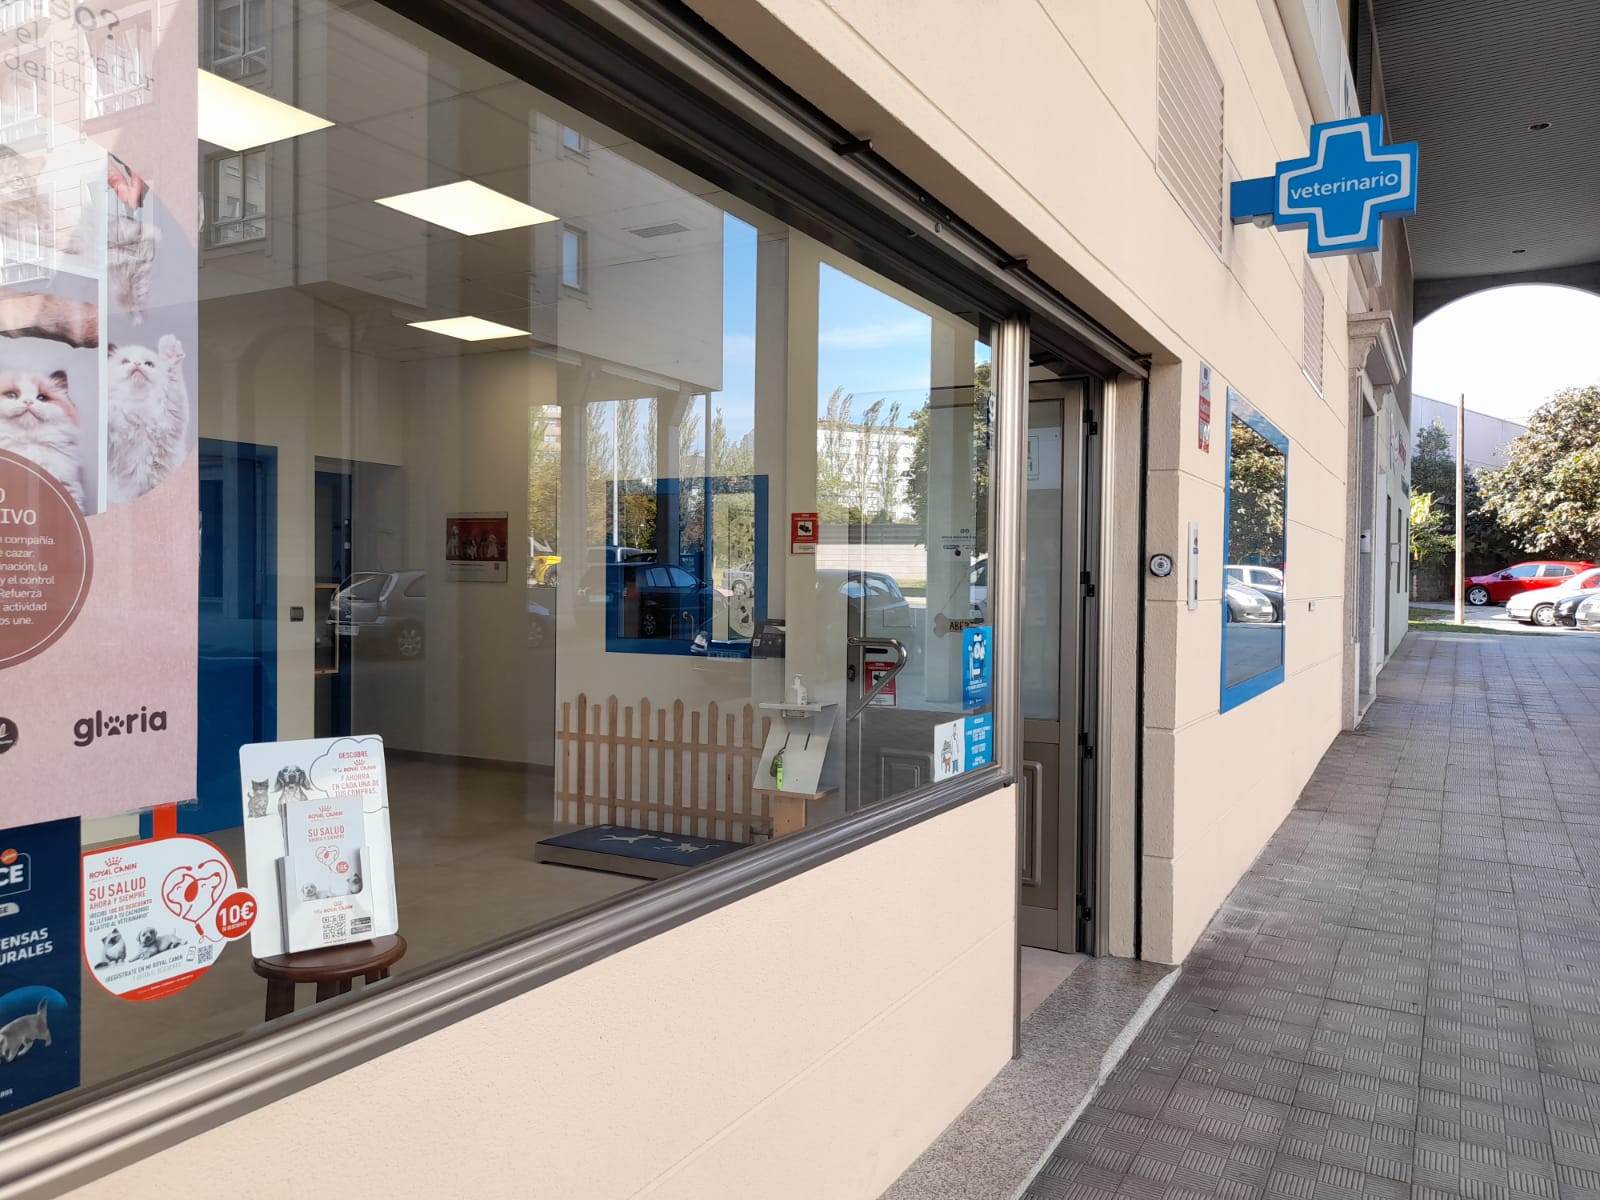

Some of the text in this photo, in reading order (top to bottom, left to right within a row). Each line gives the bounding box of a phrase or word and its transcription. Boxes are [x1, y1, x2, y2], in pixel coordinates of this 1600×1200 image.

[4, 44, 92, 95] dentr
[1291, 171, 1399, 200] veterinario
[0, 508, 37, 525] IVO
[0, 562, 37, 572] nación,
[8, 575, 17, 585] el
[20, 575, 55, 585] control
[0, 617, 10, 625] os
[74, 706, 167, 747] gloria
[308, 825, 345, 837] SU SALUD
[0, 864, 24, 886] CE
[89, 863, 137, 879] ROYAL CANIN
[89, 876, 146, 901] SU SALUD
[90, 899, 111, 910] AHORA
[119, 890, 145, 902] SIEMPRE
[219, 901, 254, 926] 10€
[0, 927, 49, 950] ENSAS
[0, 940, 53, 966] URALES
